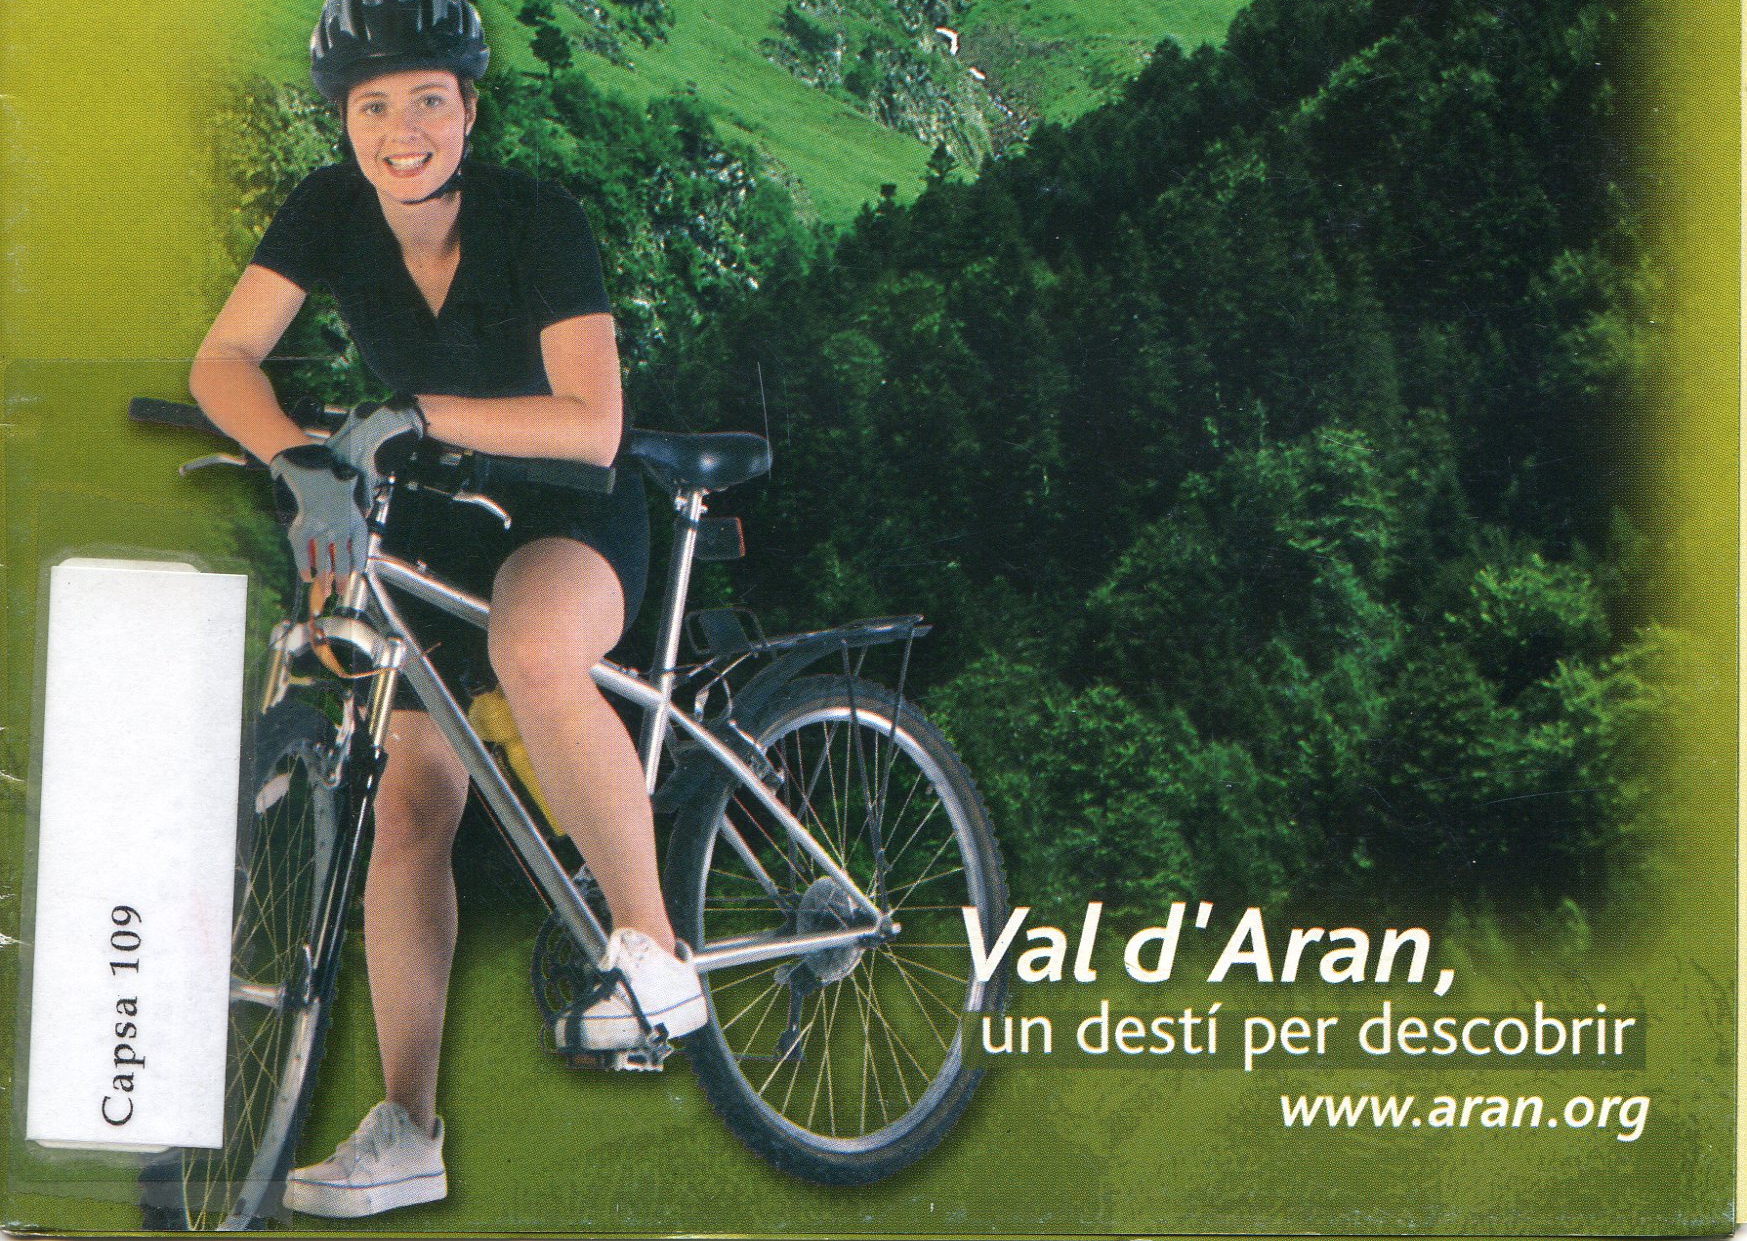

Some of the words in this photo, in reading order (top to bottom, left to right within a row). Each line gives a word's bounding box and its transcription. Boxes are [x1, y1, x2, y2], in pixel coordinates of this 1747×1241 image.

[109, 905, 142, 976] 109
[962, 903, 1103, 983] Val
[1123, 902, 1454, 997] d'Aran,
[101, 996, 146, 1127] Capsa
[981, 1017, 1052, 1055] un
[1076, 1001, 1222, 1055] destí
[1244, 1017, 1338, 1072] per
[1359, 1001, 1636, 1056] descobrir
[1280, 1095, 1650, 1142] www.aran.org
